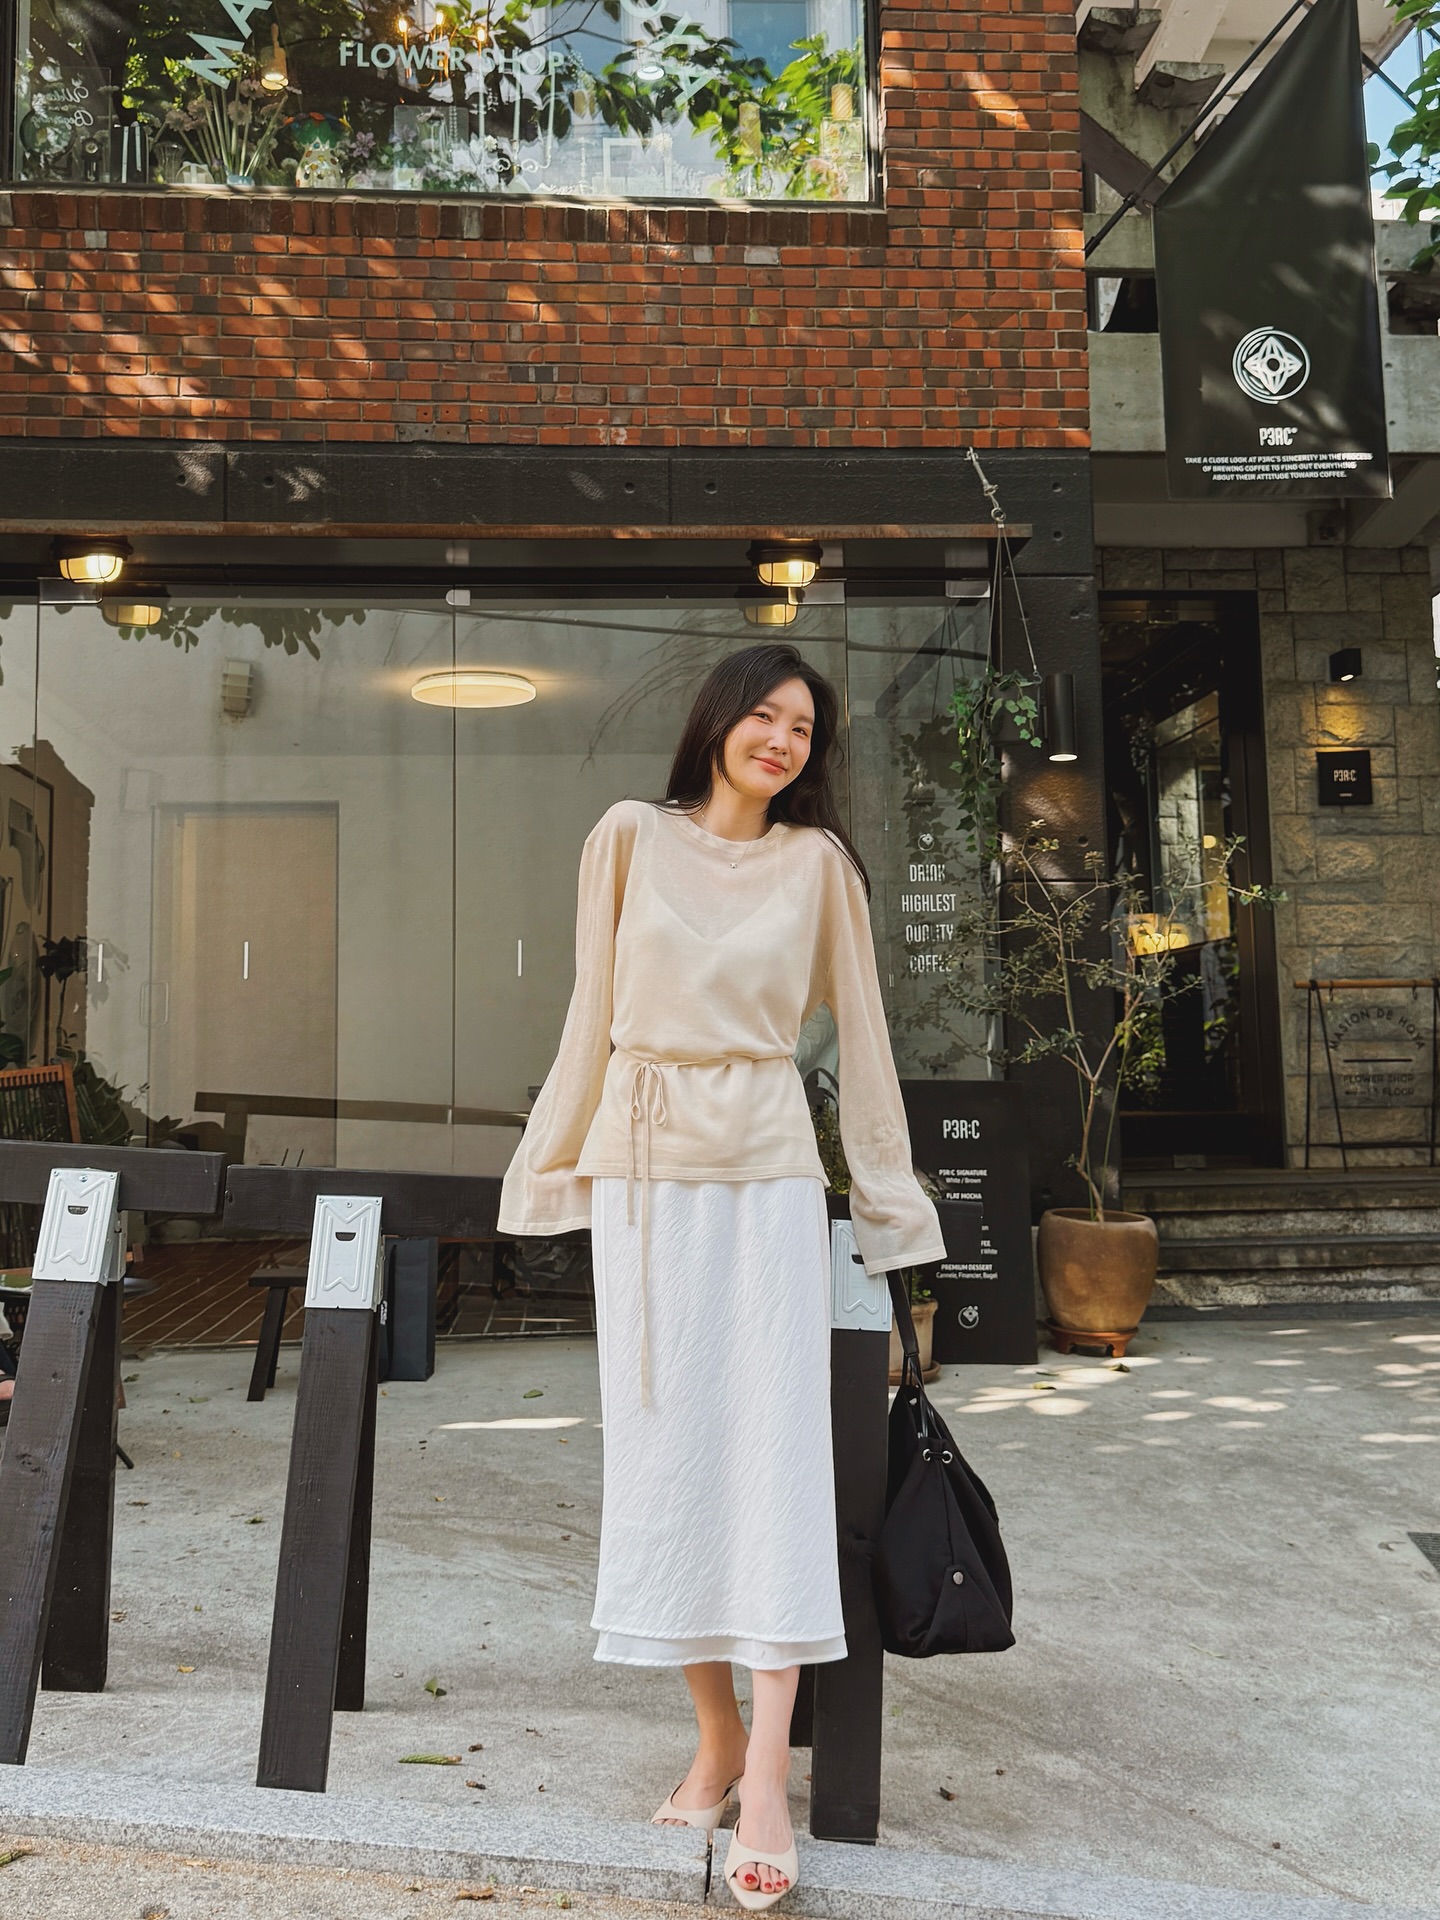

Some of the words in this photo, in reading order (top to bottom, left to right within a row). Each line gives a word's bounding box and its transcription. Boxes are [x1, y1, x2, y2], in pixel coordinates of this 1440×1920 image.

[339, 42, 466, 71] FLOWER
[484, 48, 564, 76] SHOP
[1202, 465, 1211, 473] OF
[1212, 465, 1244, 473] BREWING
[1271, 464, 1280, 472] TO
[1281, 463, 1298, 471] FIND
[1298, 463, 1312, 471] OUT
[1313, 461, 1357, 471] EVERYTHING
[1208, 456, 1229, 464] CLOSE
[1229, 456, 1247, 464] LOOK
[1281, 454, 1318, 463] SINCERITY
[1328, 453, 1341, 461] THE
[1235, 473, 1256, 481] THEIR
[1256, 472, 1290, 480] ATTITUDE
[1290, 471, 1319, 479] TOWARD
[1319, 470, 1347, 478] COFFEE.
[909, 864, 945, 882] DRINK
[901, 894, 956, 912] HIGHLEST
[1376, 1007, 1393, 1020] DE
[1398, 1016, 1426, 1050] HOYA
[943, 1119, 980, 1139] P3R:C
